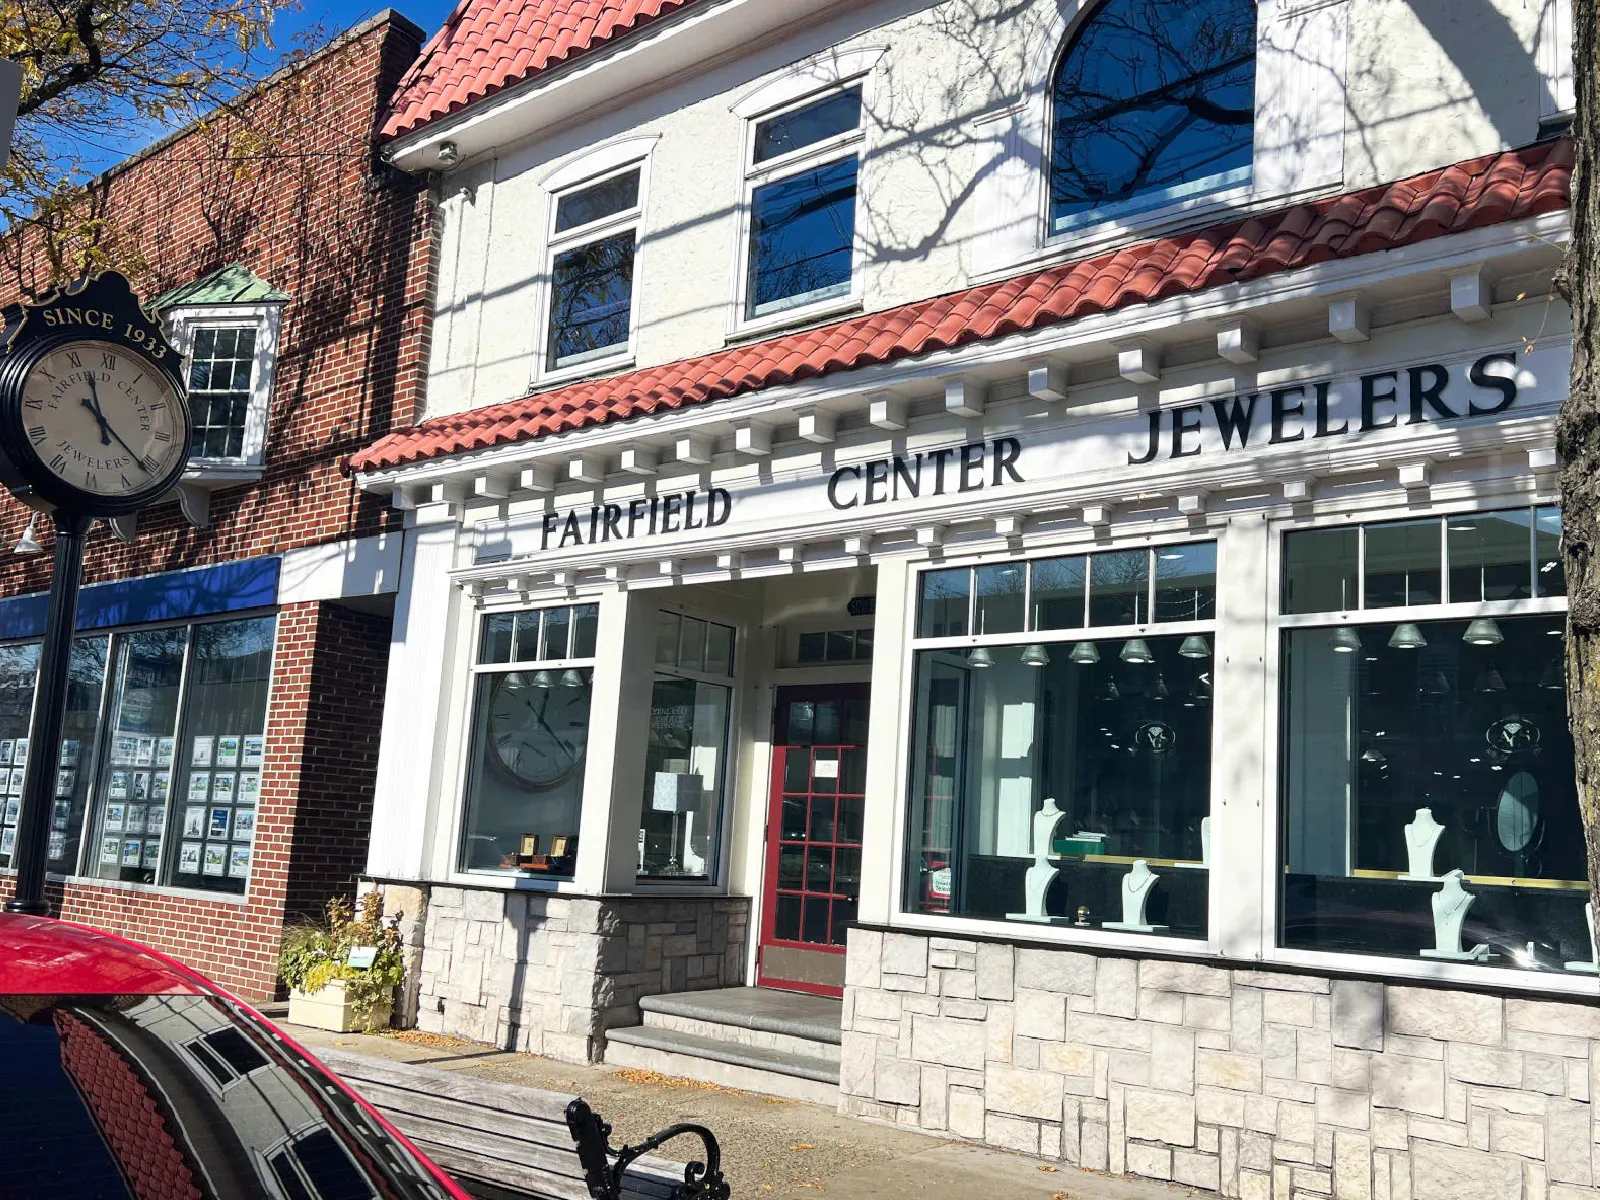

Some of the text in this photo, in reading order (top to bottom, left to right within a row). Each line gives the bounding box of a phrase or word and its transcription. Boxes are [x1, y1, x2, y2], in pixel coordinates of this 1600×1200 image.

[43, 308, 167, 359] SINCE 1933
[67, 351, 82, 368] XI
[100, 352, 116, 371] XII
[48, 371, 150, 431] FAIRFIELD CENTER
[56, 440, 131, 470] JEWELERS
[540, 351, 1519, 550] FAIRFIELD CENTER JEWELERS
